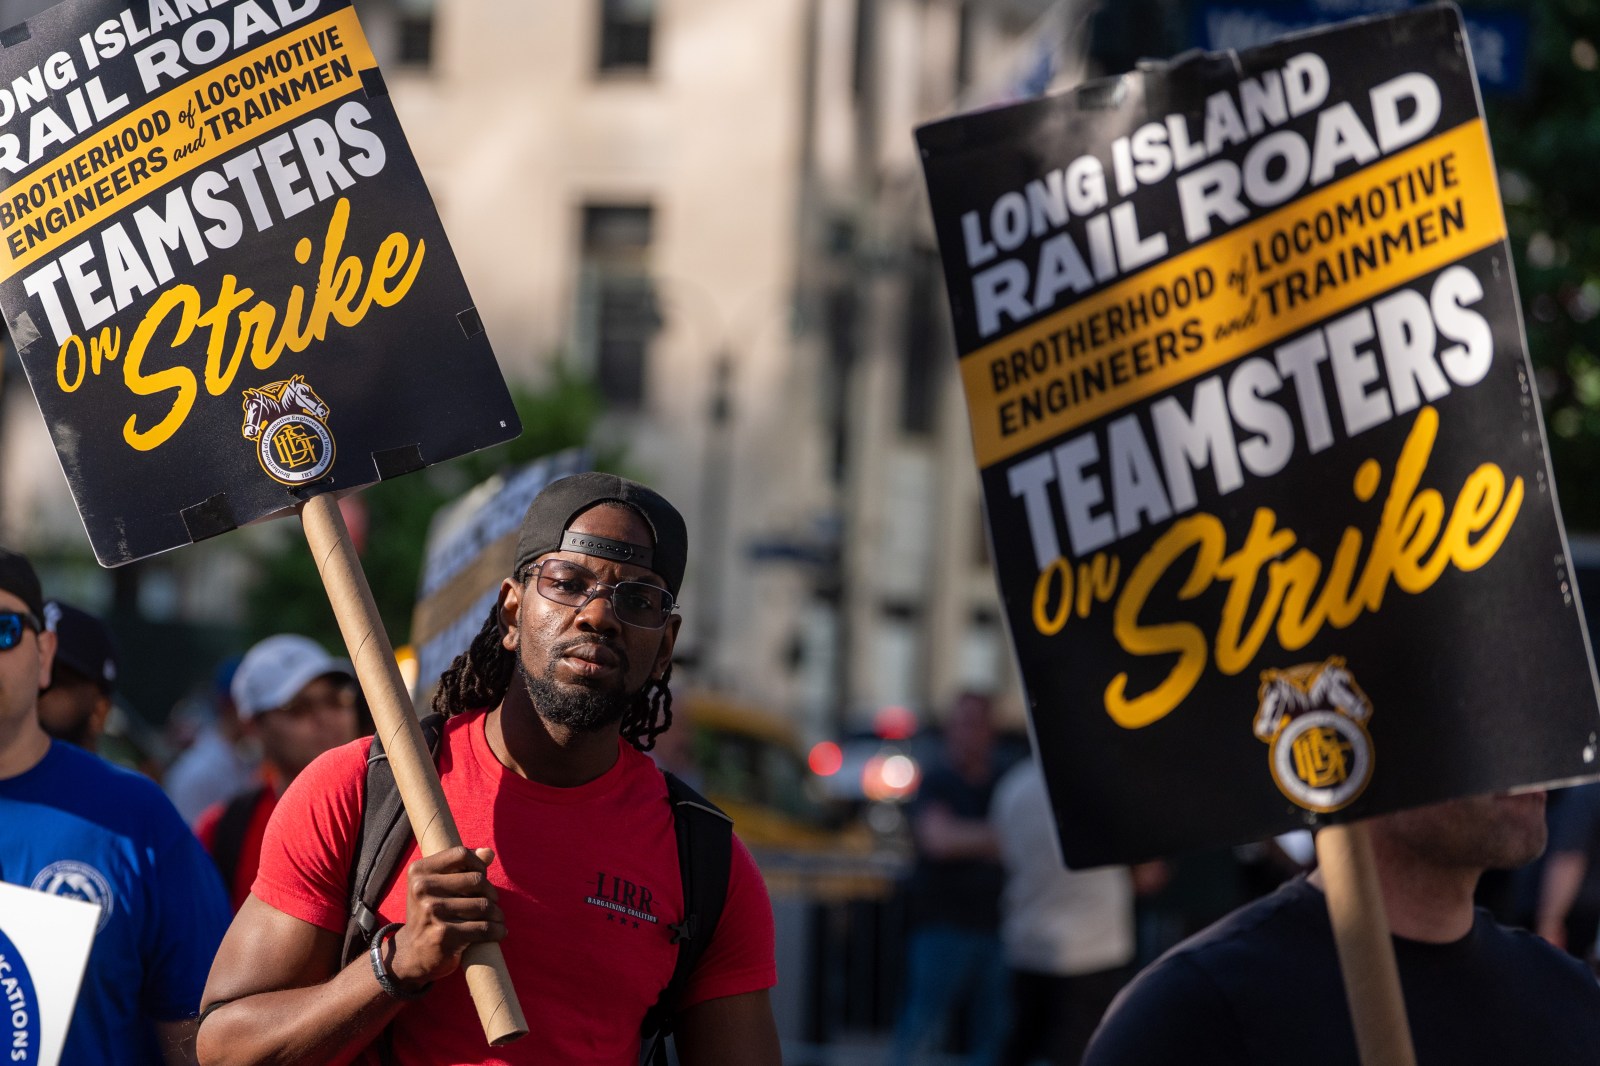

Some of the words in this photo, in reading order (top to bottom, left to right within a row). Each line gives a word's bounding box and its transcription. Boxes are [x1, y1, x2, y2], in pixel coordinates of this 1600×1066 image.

[0, 76, 130, 174] RAIL
[133, 0, 322, 94] ROAD
[0, 51, 79, 126] ONG
[0, 110, 171, 230] BROTHERHOOD
[178, 99, 197, 129] of
[195, 25, 343, 113] LOCOMOTIVE
[7, 145, 168, 260] ENGINEERS
[173, 127, 206, 162] and
[205, 55, 353, 141] TRAINMEN
[961, 155, 1108, 268] LONG
[1111, 52, 1331, 196] ISLAND
[23, 101, 387, 346] TEAMSTERS
[972, 202, 1168, 337] RAIL
[1178, 72, 1442, 244] ROAD
[991, 265, 1217, 394] BROTHERHOOD
[1226, 252, 1251, 296] of
[1253, 153, 1459, 276] LOCOMOTIVE
[57, 326, 121, 393] On
[122, 197, 426, 451] Strike
[999, 317, 1203, 436] ENGINEERS
[1213, 302, 1262, 346] and
[1263, 199, 1466, 320] TRAINMEN
[1007, 265, 1494, 570] TEAMSTERS
[263, 450, 291, 479] Brotherhood
[265, 417, 291, 442] Locomotive
[291, 415, 320, 431] Engineers
[319, 429, 328, 440] and
[320, 439, 331, 467] Trainmen
[1033, 552, 1120, 636] On
[1104, 405, 1524, 729] Strike
[587, 897, 626, 913] BARGAINING
[627, 908, 657, 922] COALITION
[596, 872, 653, 913] LIRR
